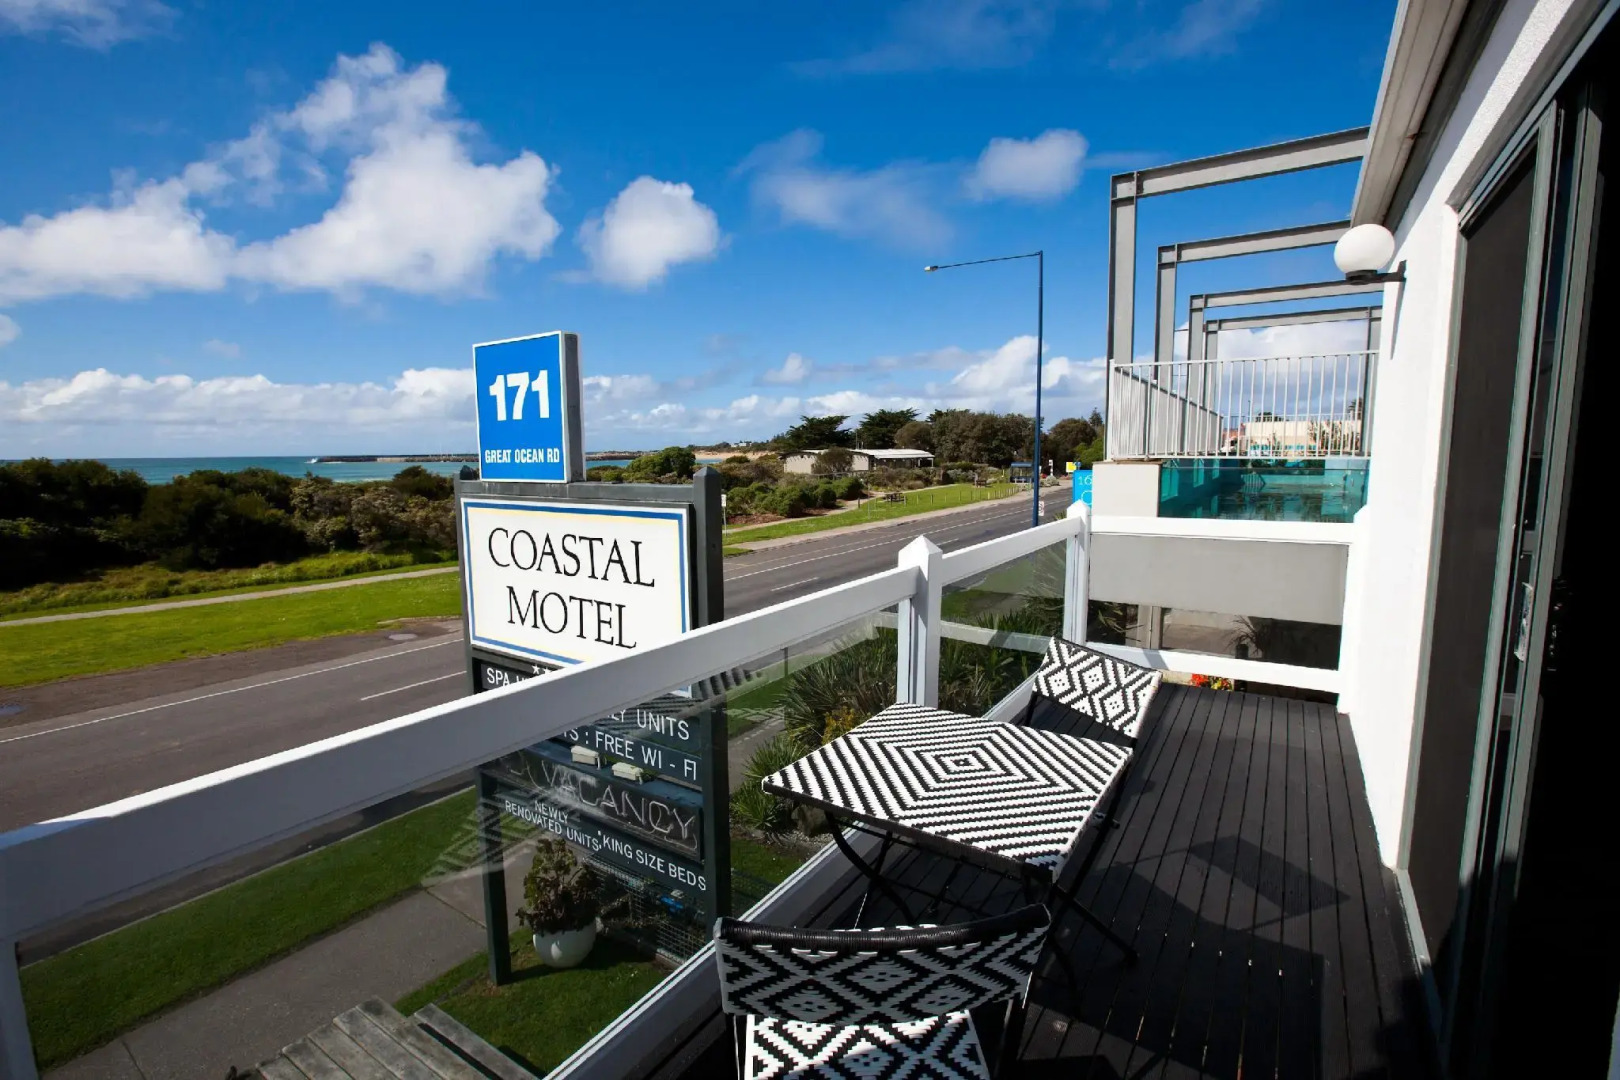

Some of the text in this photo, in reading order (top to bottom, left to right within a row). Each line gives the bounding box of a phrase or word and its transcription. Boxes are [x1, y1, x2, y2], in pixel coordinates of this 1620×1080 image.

[489, 370, 550, 421] 171
[485, 447, 560, 464] GREAT OCEAN RD
[488, 527, 655, 587] COASTAL
[506, 585, 637, 649] MOTEL
[486, 667, 510, 687] SPA
[595, 730, 635, 760] FREE
[637, 708, 690, 741] UNITS
[504, 800, 600, 851] RENOVATED UNITS
[534, 800, 569, 824] NEWLY
[603, 834, 707, 891] KING SIZE BEDS
